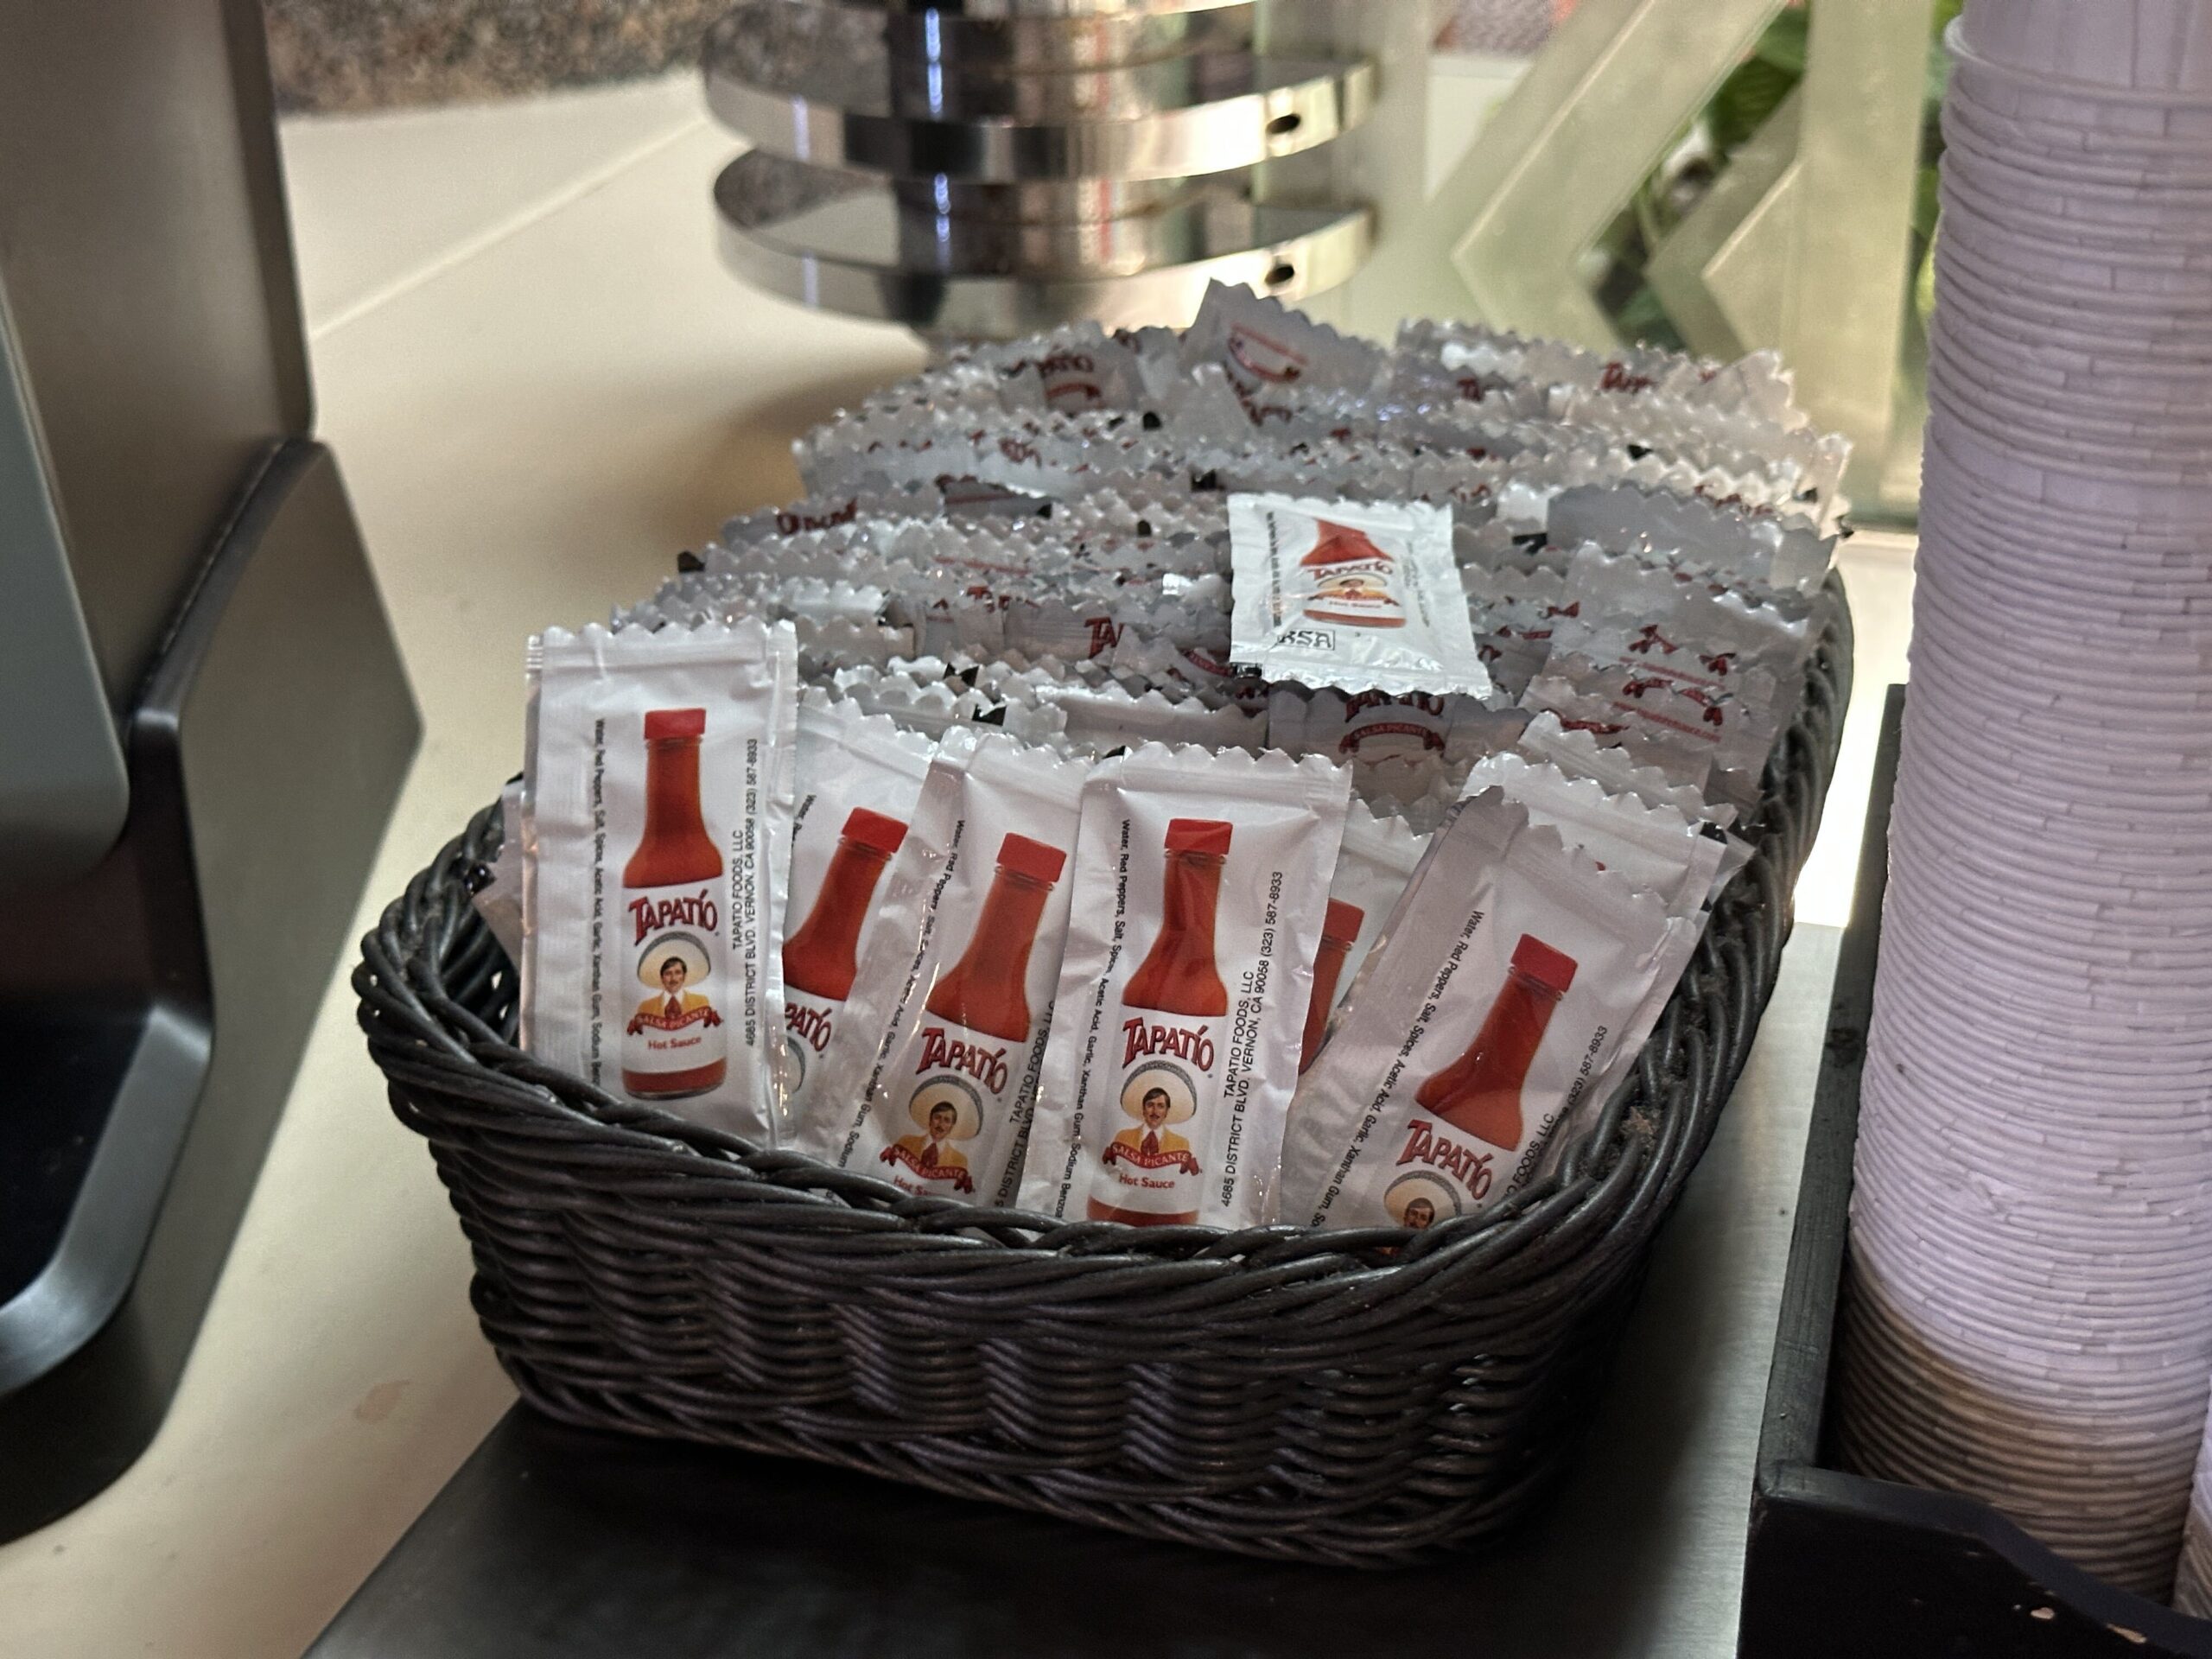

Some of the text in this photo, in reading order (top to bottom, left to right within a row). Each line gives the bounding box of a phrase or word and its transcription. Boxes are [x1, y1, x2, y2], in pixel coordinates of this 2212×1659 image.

[746, 738, 756, 785] 587-8933
[746, 787, 757, 814] (323)
[733, 830, 742, 851] LLC
[746, 817, 754, 849] 90058
[1116, 818, 1133, 851] Water,
[745, 853, 754, 868] CA
[944, 851, 958, 872] Red
[1117, 853, 1130, 873] Red
[1111, 874, 1130, 918] Peppers,
[731, 902, 742, 949] TAPATIO
[1111, 919, 1124, 941] Salt,
[1459, 908, 1484, 941] Water,
[1450, 939, 1469, 963] Red
[593, 954, 601, 991] Xanthan
[745, 962, 755, 1015] DISTRICT
[1427, 958, 1459, 1003] Peppers,
[1095, 977, 1109, 1007] Acetic
[1089, 1008, 1102, 1033] Acid,
[1416, 1001, 1437, 1026] Salt,
[592, 1021, 601, 1058] Sodium
[648, 1036, 702, 1050] Hot Sauce
[1082, 1034, 1097, 1067] Garlic,
[1219, 870, 1283, 1207] 4685 DISTRICT BLVD. VERNON, CA 90058 (323) 587-8933
[1223, 970, 1254, 1099] TAPATIO FOODS, LLC
[1397, 1023, 1425, 1061] Spices,
[1383, 1058, 1407, 1090] Acetic
[1564, 1024, 1608, 1106] (323) 587-8933
[863, 1063, 884, 1102] Xanthan
[1009, 1073, 1035, 1125] TAPATIO
[1075, 1070, 1090, 1109] Xanthan
[852, 1103, 871, 1130] Gum,
[1369, 1087, 1391, 1116] Acid,
[1351, 1113, 1377, 1147] Garlic,
[1535, 1111, 1554, 1136] LLC
[837, 1129, 861, 1169] Sodium
[1063, 1142, 1080, 1180] Sodium
[1113, 1144, 1190, 1166] SALSA PICANTE
[1332, 1144, 1361, 1186] Xanthan
[893, 1175, 913, 1192] Hot
[921, 1166, 964, 1179] PICANTE
[997, 1140, 1025, 1198] DISTRICT
[1119, 1173, 1175, 1189] Hot Sauce
[1317, 1183, 1340, 1213] Gum,
